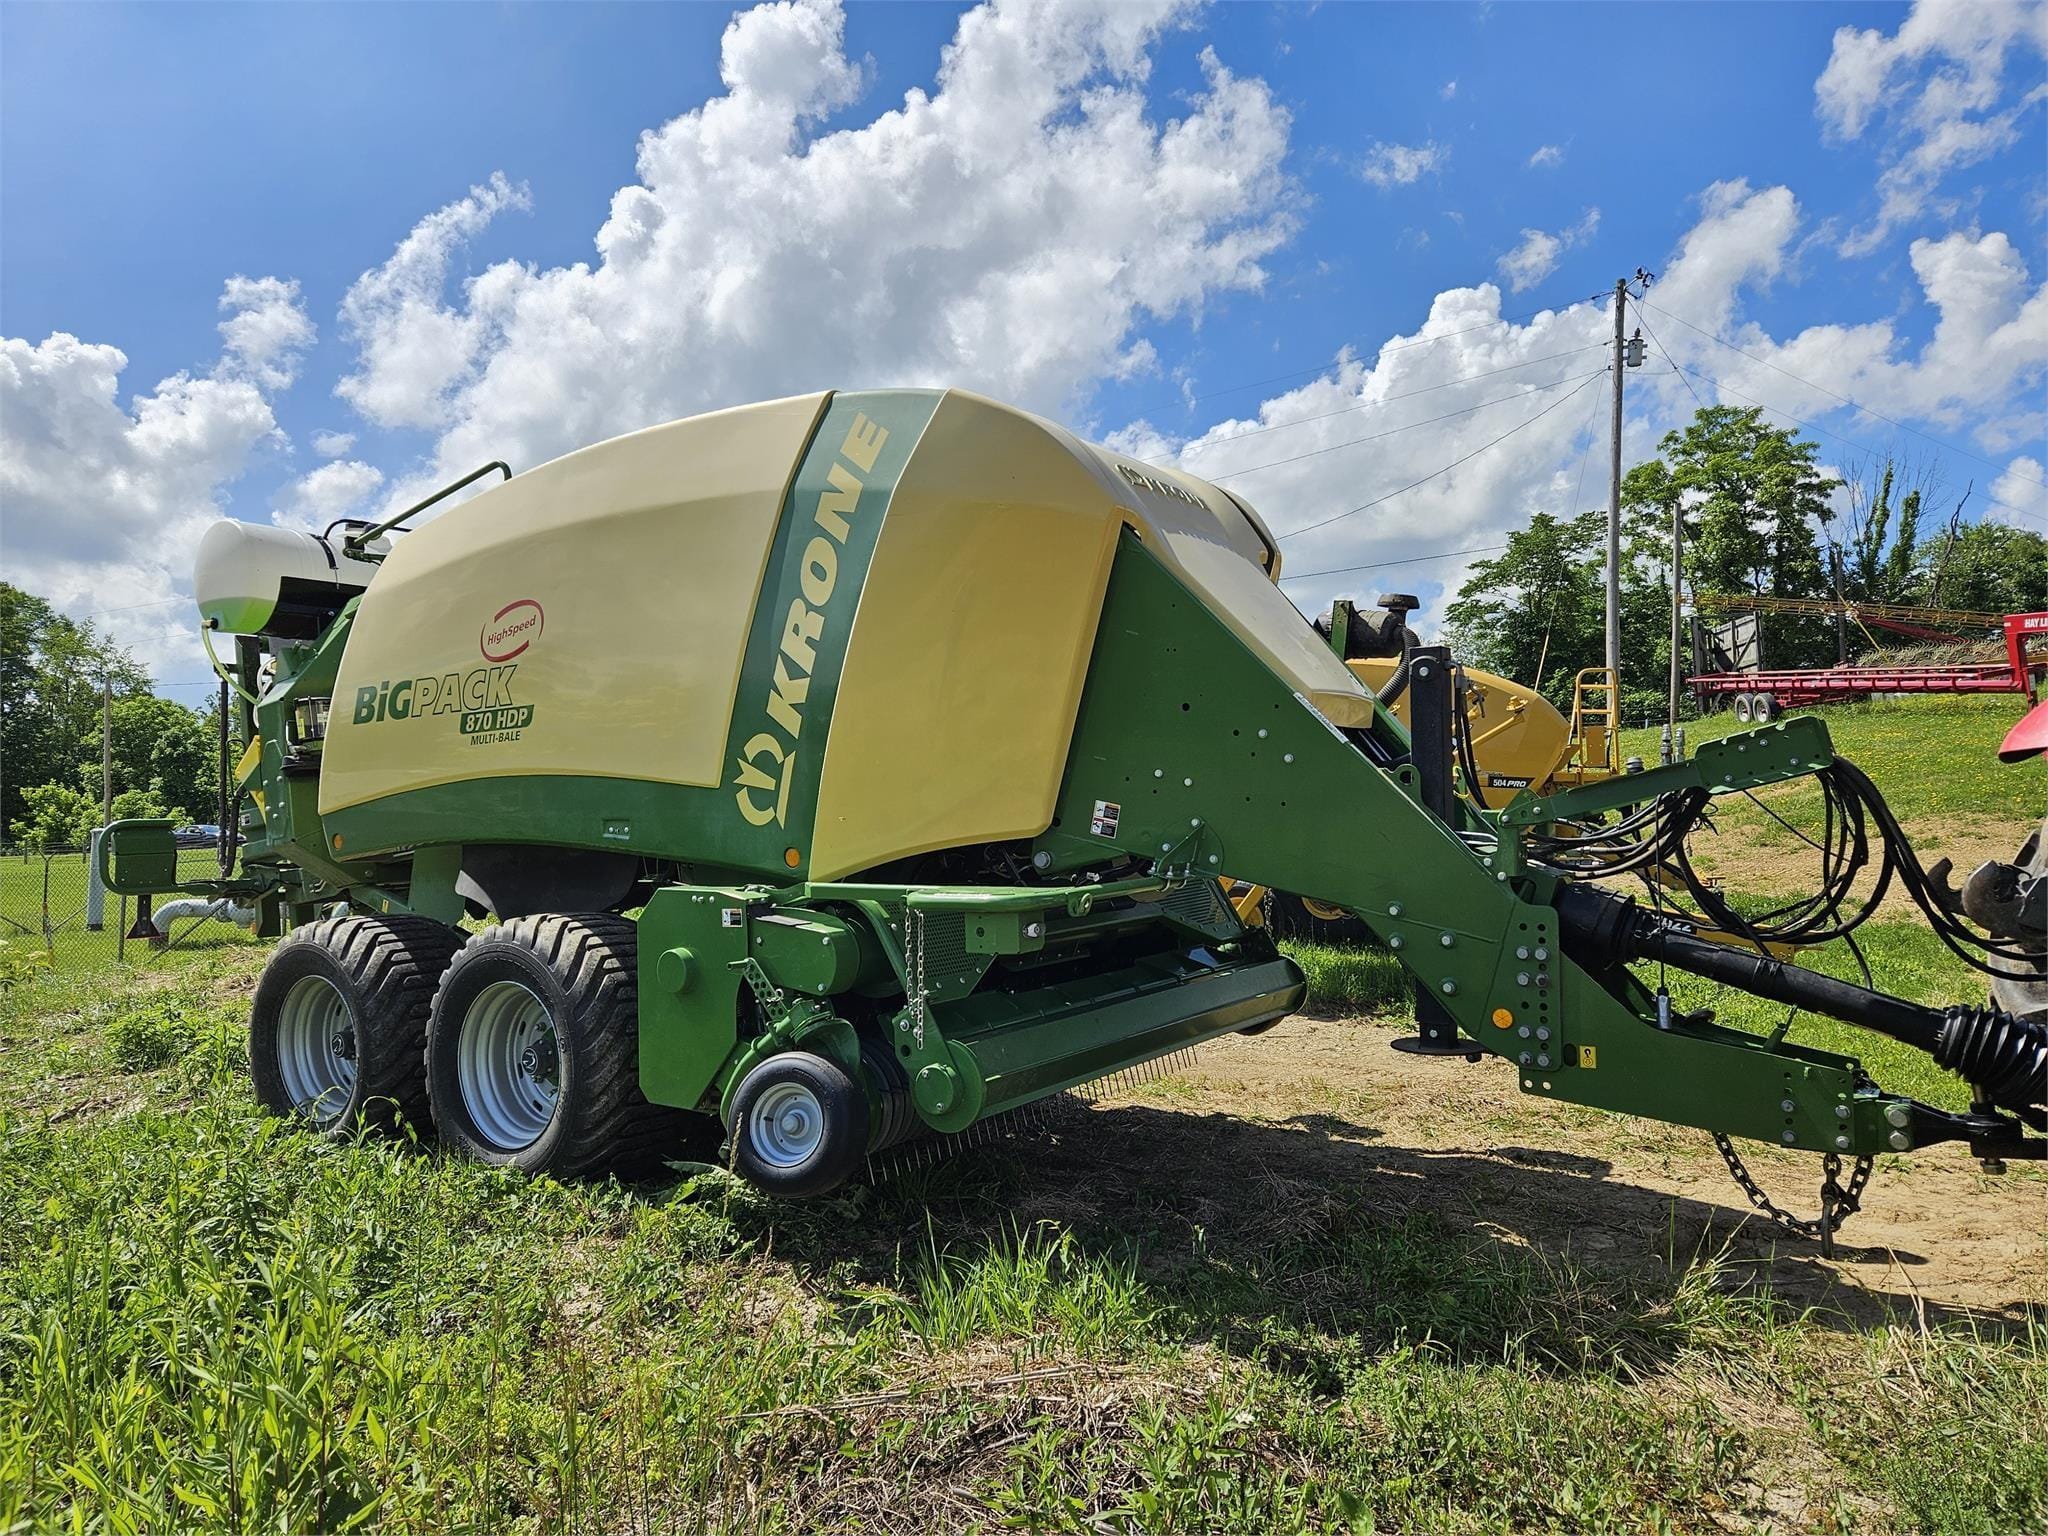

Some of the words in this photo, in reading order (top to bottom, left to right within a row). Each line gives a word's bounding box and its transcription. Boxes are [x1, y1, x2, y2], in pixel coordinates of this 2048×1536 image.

[766, 411, 889, 740] KRONE
[488, 614, 536, 646] HighSpeed
[2024, 618, 2040, 628] HAY
[466, 712, 493, 732] 870
[496, 708, 528, 729] HDP
[470, 731, 521, 746] MULTI-BALE
[1493, 779, 1507, 787] 504
[1507, 780, 1527, 788] PRO
